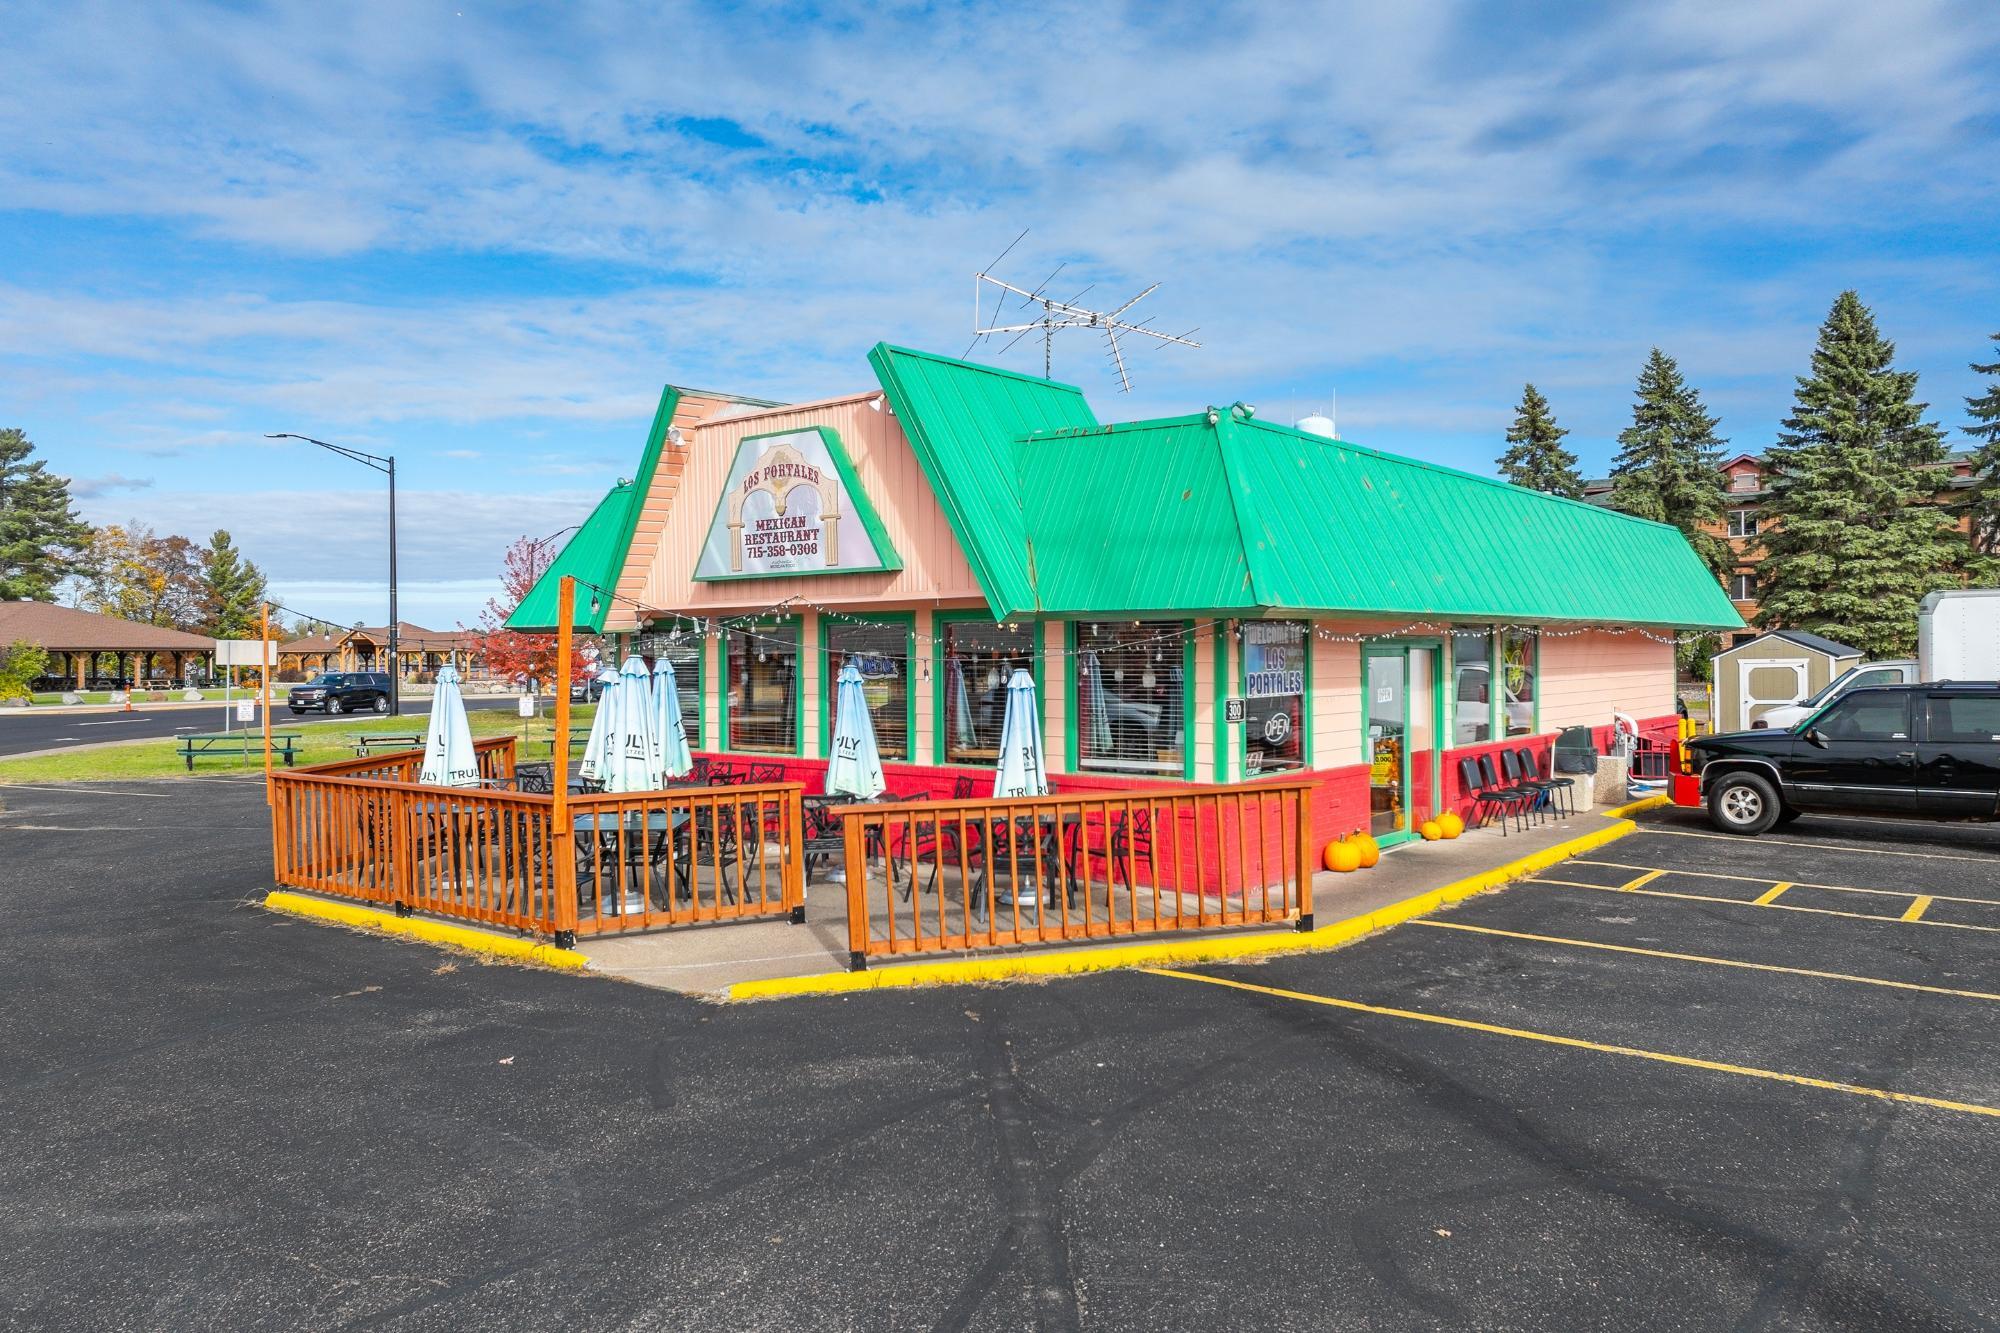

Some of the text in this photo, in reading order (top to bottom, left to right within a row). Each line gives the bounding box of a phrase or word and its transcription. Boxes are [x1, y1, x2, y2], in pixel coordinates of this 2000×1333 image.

[743, 463, 819, 494] LOS PORTALES
[756, 516, 806, 531] MEXICAN
[744, 528, 820, 546] RESTAURANT
[747, 543, 818, 558] 715-358-0308
[1265, 647, 1286, 671] LOS
[1248, 671, 1302, 697] PORTALES
[1229, 704, 1241, 716] 300
[1264, 718, 1290, 737] OPEN
[449, 768, 480, 780] TRUL
